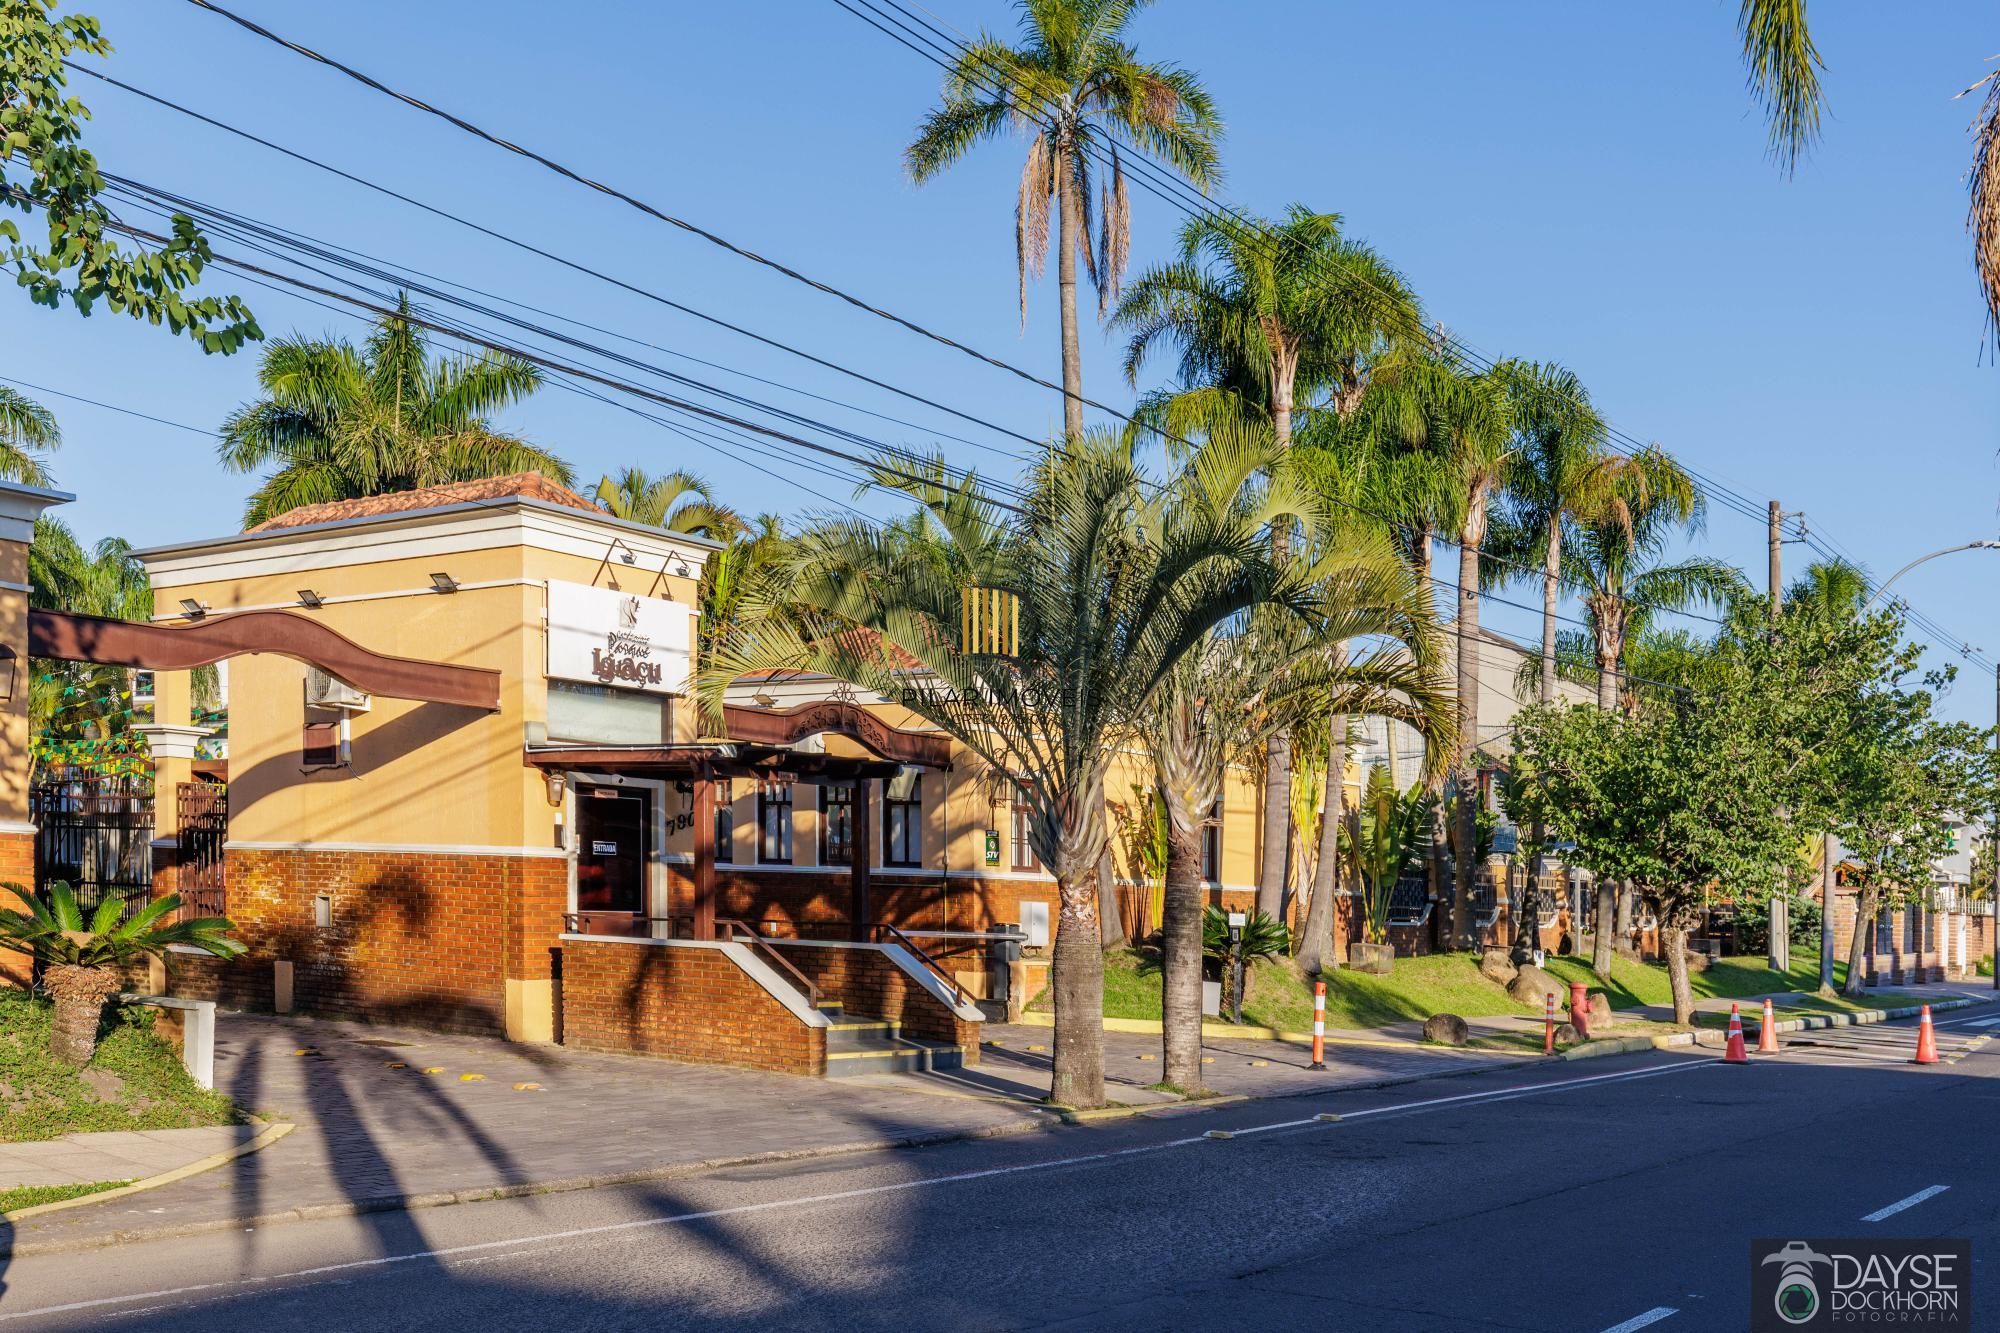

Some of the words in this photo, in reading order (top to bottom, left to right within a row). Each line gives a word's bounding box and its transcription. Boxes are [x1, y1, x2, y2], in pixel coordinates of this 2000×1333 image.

[591, 647, 663, 688] Iguaçu
[594, 843, 616, 853] ENTRADA
[986, 851, 999, 859] STV
